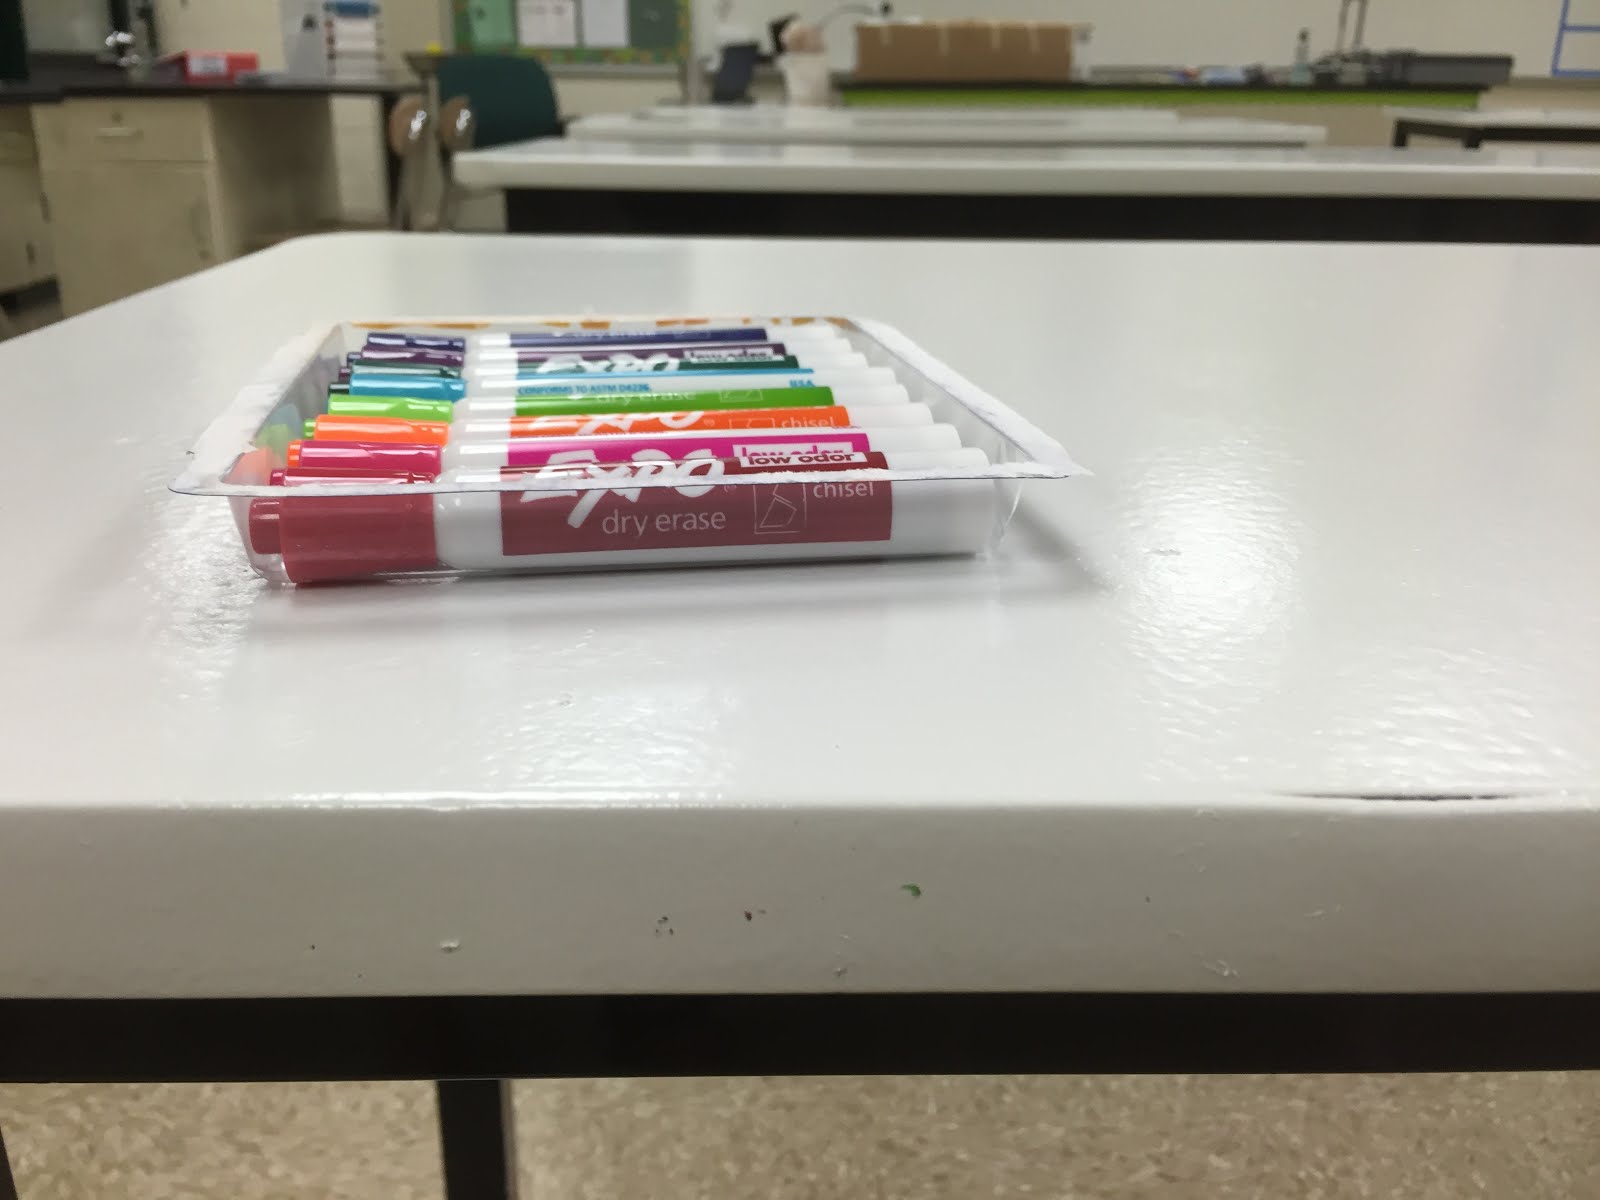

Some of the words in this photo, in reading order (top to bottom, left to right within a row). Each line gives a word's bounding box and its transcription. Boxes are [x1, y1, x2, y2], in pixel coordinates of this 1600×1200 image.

[576, 385, 587, 394] TO
[590, 384, 617, 393] ASTM
[789, 379, 816, 388] USA
[781, 416, 835, 428] chisel
[749, 455, 791, 466] low
[798, 453, 855, 464] odor
[813, 481, 875, 498] chisel
[602, 509, 649, 537] dry
[655, 511, 727, 532] erase
